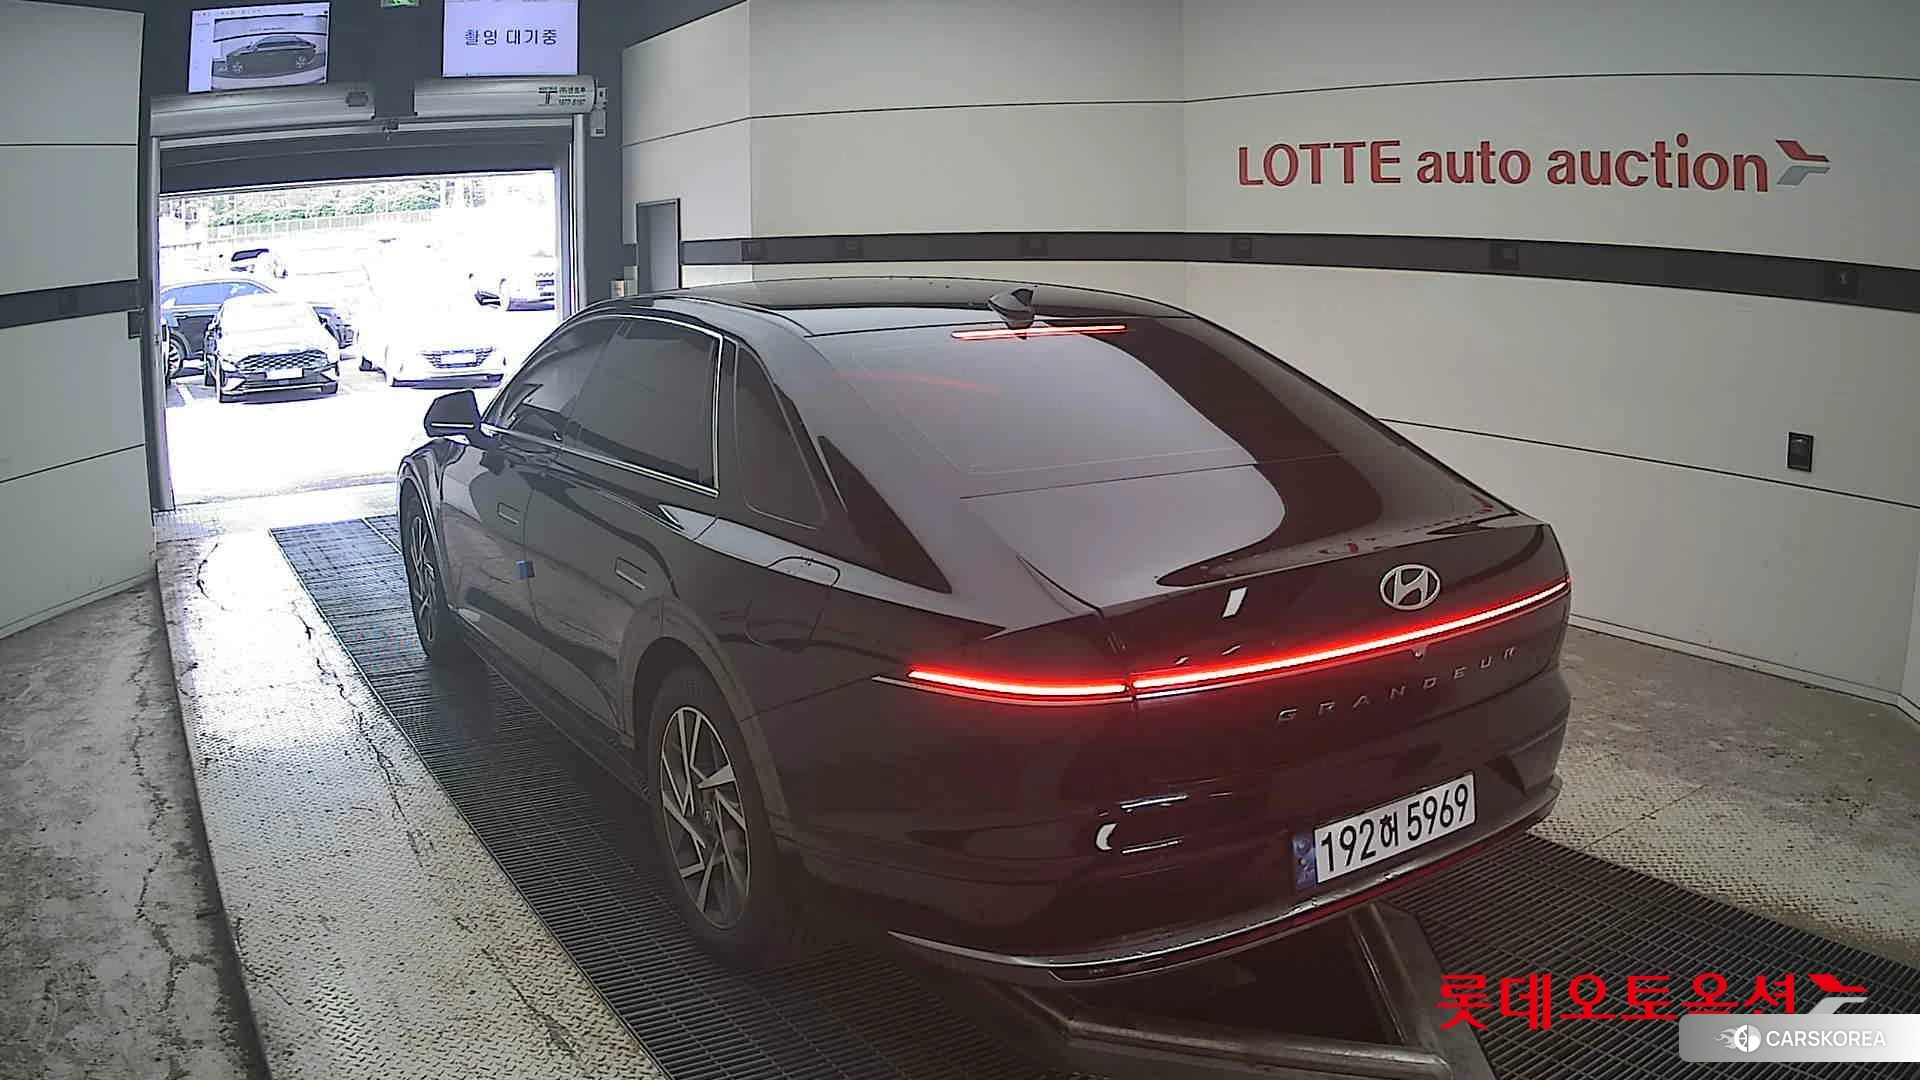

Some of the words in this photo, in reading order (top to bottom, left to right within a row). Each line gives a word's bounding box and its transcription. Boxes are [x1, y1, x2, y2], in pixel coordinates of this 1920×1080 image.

[506, 29, 557, 46] 대기중
[1238, 140, 1401, 187] LOTTE
[1416, 140, 1532, 185] auto
[1547, 132, 1768, 193] auction
[1277, 646, 1518, 722] GRANDEUR
[1320, 811, 1399, 873] 192허
[1407, 783, 1469, 842] 5969
